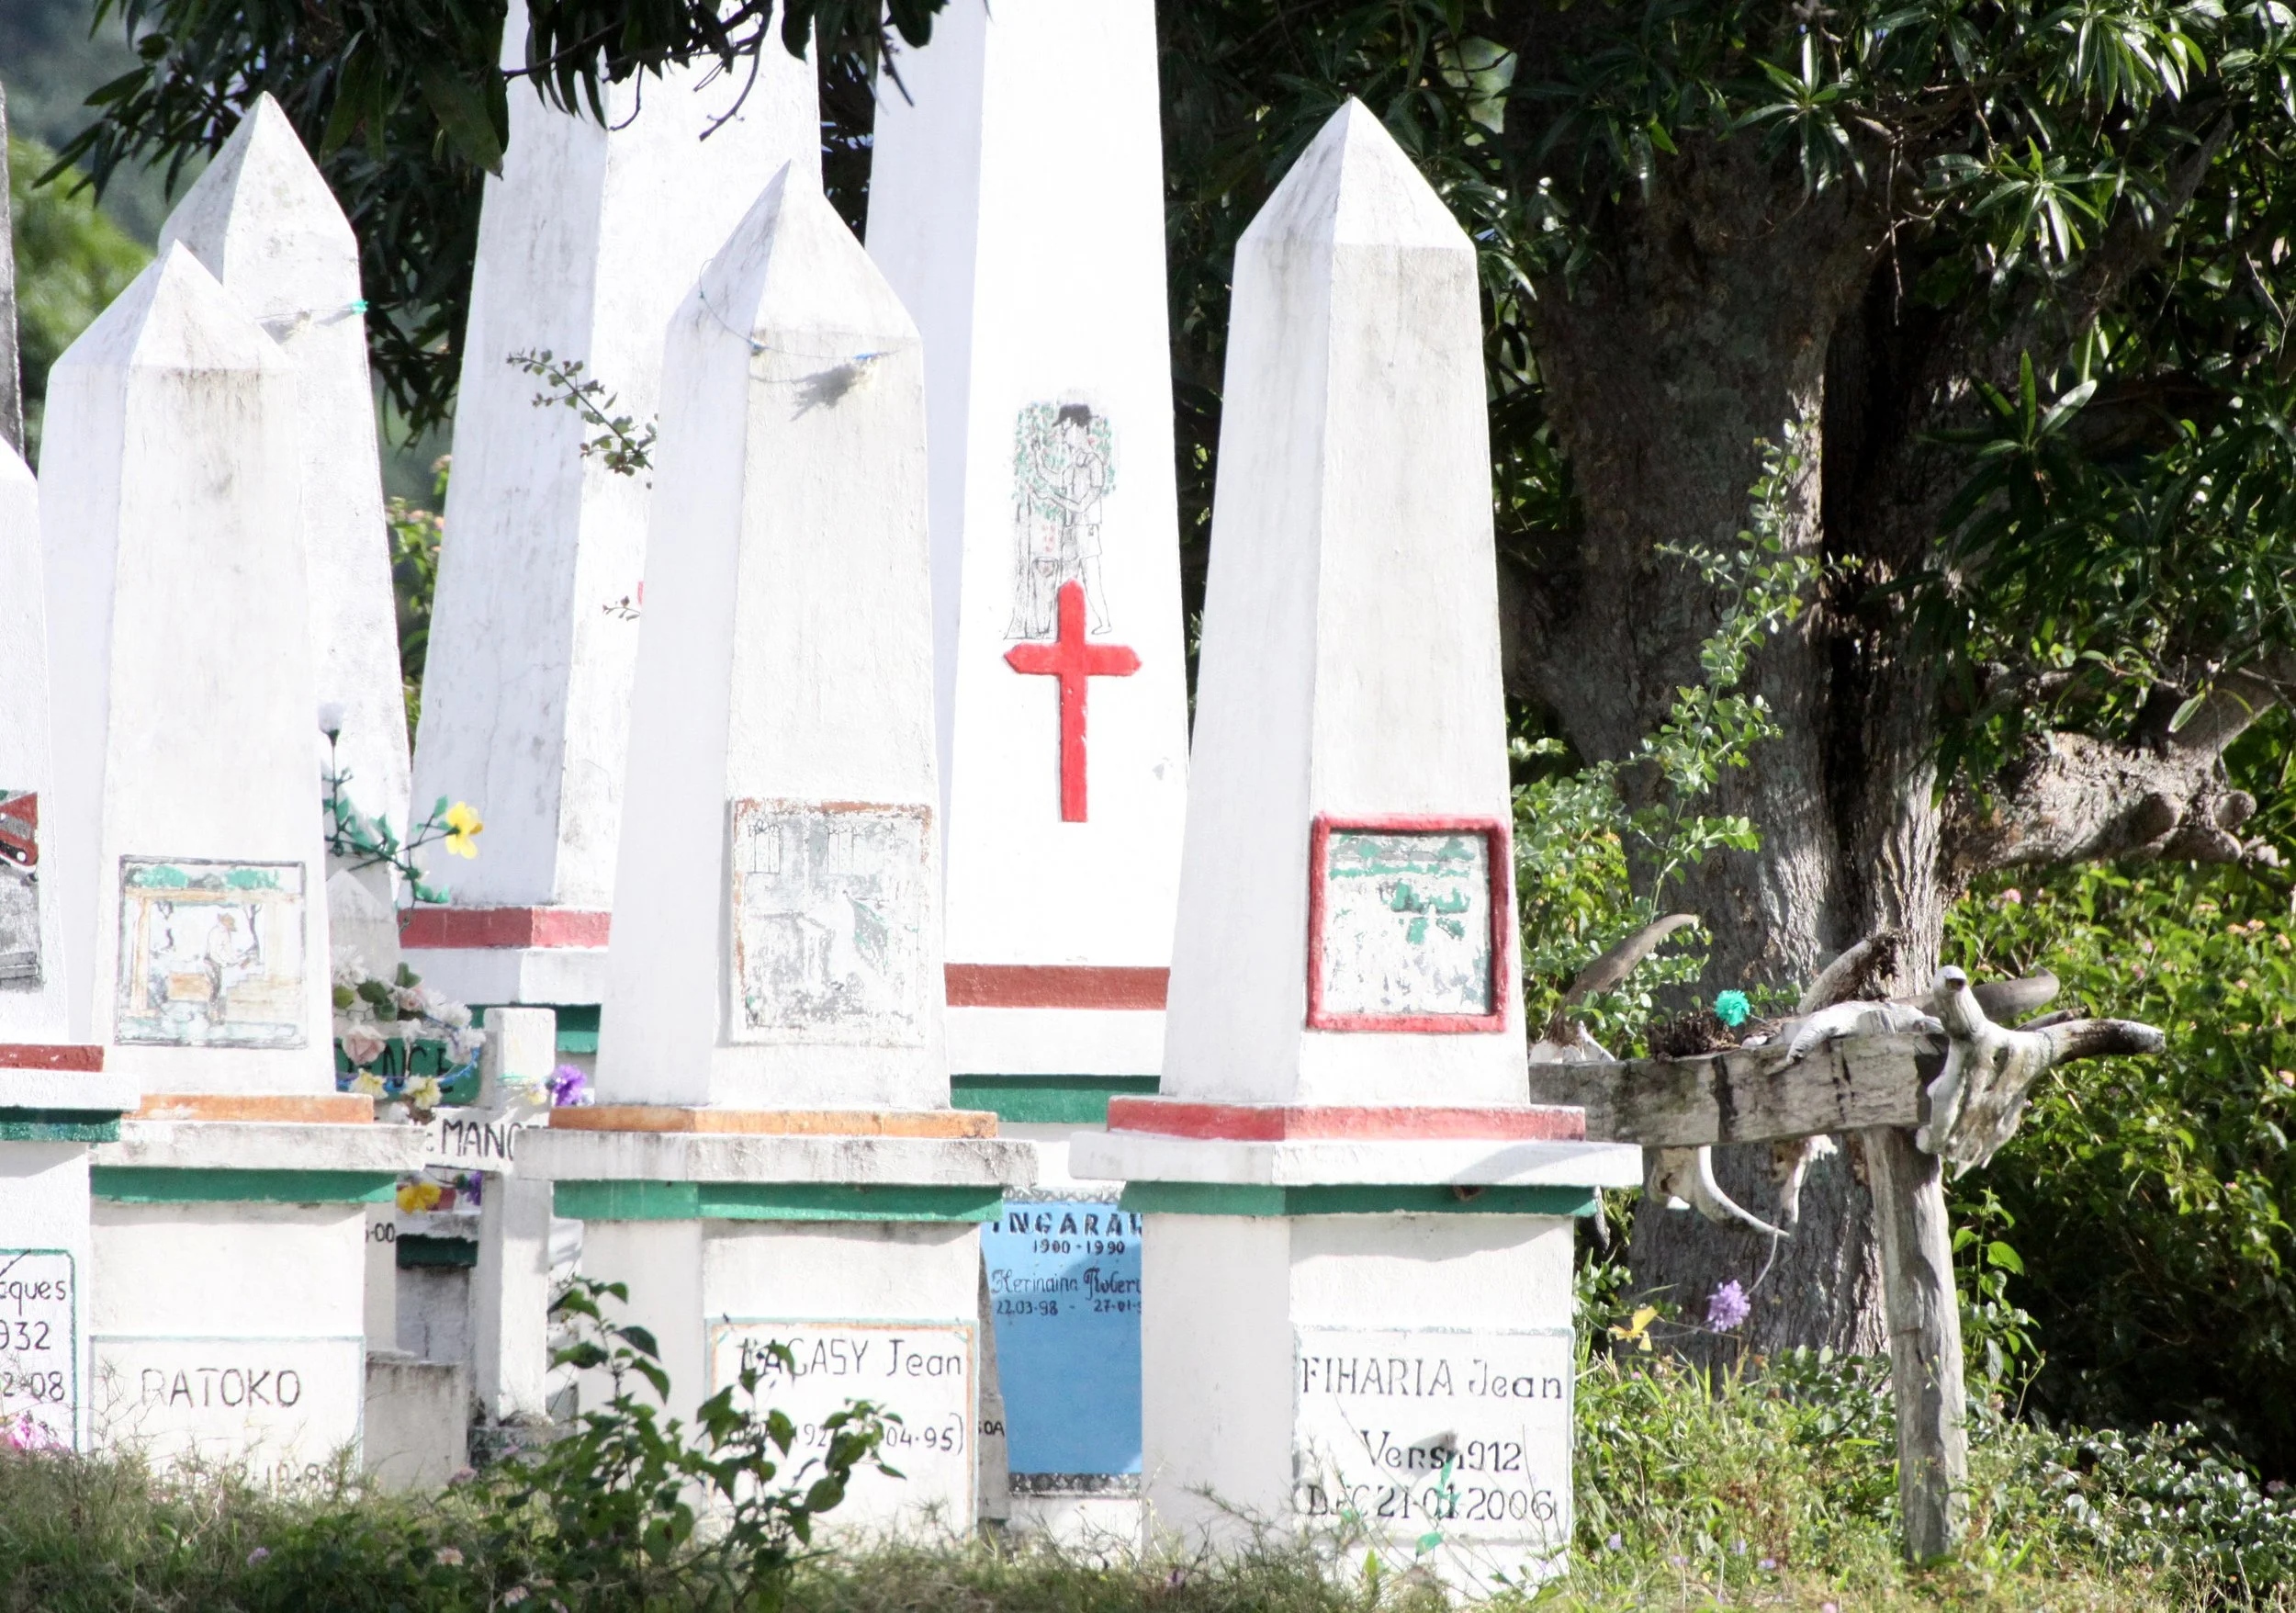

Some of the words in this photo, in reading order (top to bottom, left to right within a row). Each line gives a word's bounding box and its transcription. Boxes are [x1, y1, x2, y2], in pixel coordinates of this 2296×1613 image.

[884, 1338, 962, 1377] Jean
[1300, 1357, 1454, 1397] FIHARIA
[1469, 1359, 1563, 1399] Jean
[141, 1368, 302, 1408] RATOKO
[1360, 1429, 1445, 1471] Vers
